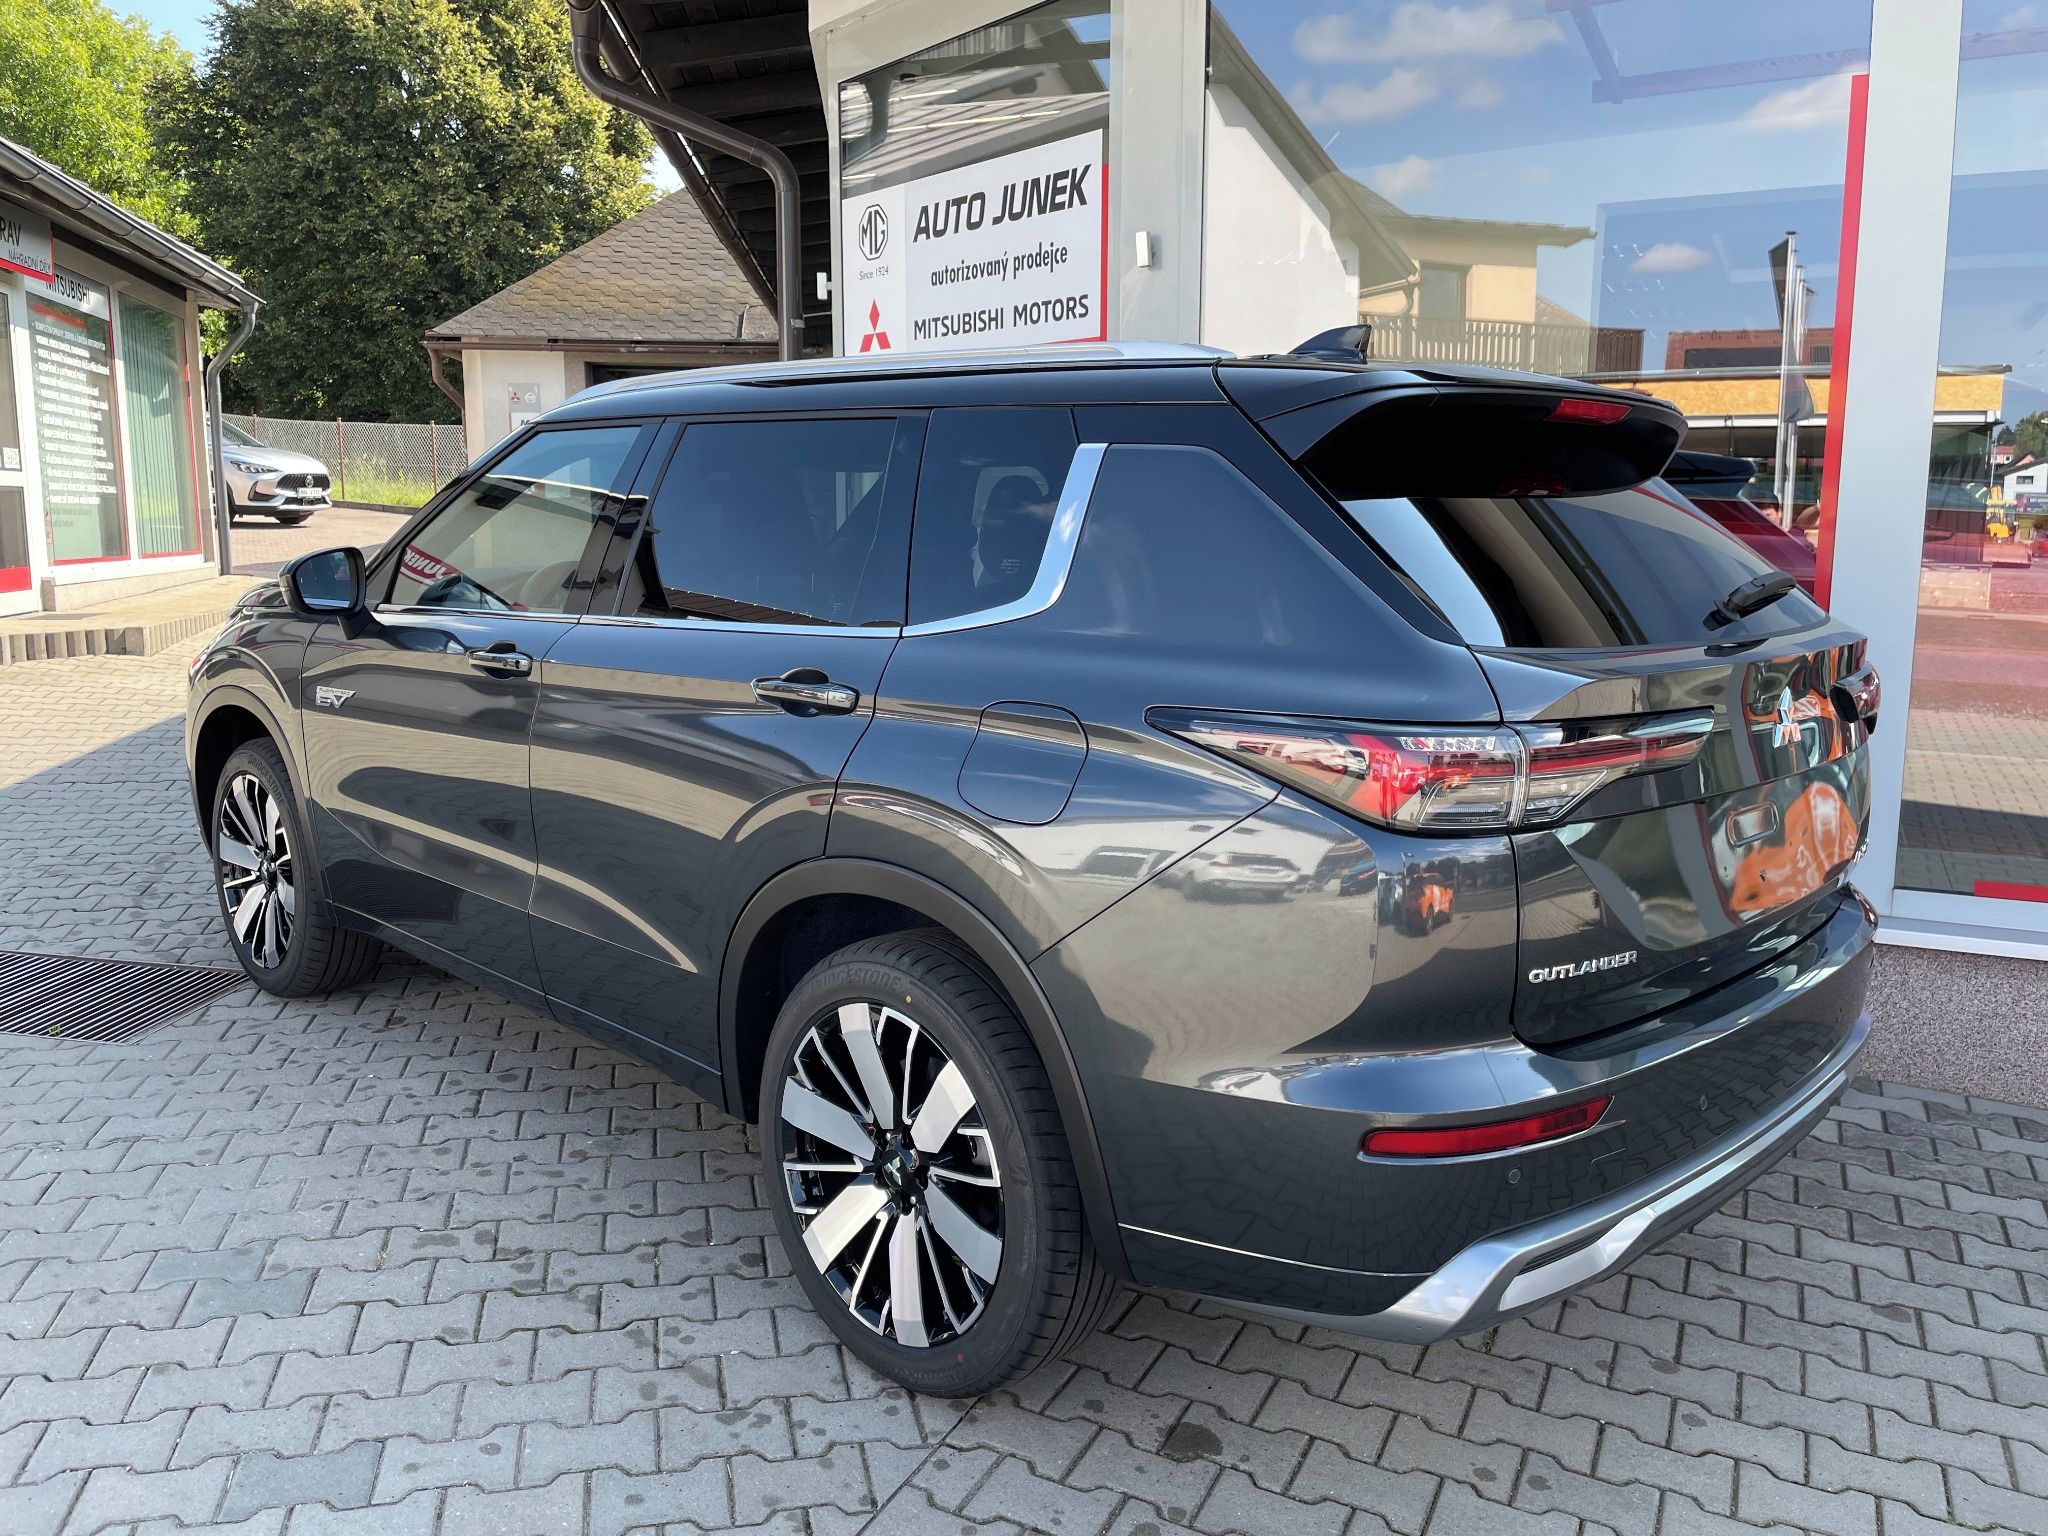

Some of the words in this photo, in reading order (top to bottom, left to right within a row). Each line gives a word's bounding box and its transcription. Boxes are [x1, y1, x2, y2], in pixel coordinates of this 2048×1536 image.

[913, 191, 986, 243] AUTO
[992, 163, 1092, 226] JUNEK
[861, 207, 886, 257] MG
[8, 248, 38, 270] NÁHRADNÍ
[859, 270, 873, 281] Since
[876, 265, 889, 278] 1924
[931, 250, 1009, 287] autorizovaný
[1013, 241, 1068, 280] prodejce
[913, 307, 1004, 341] MITSUBISHI
[1013, 293, 1089, 328] MOTORS
[248, 753, 285, 807] BRIDGESTONE
[1528, 950, 1638, 984] OUTLANDER
